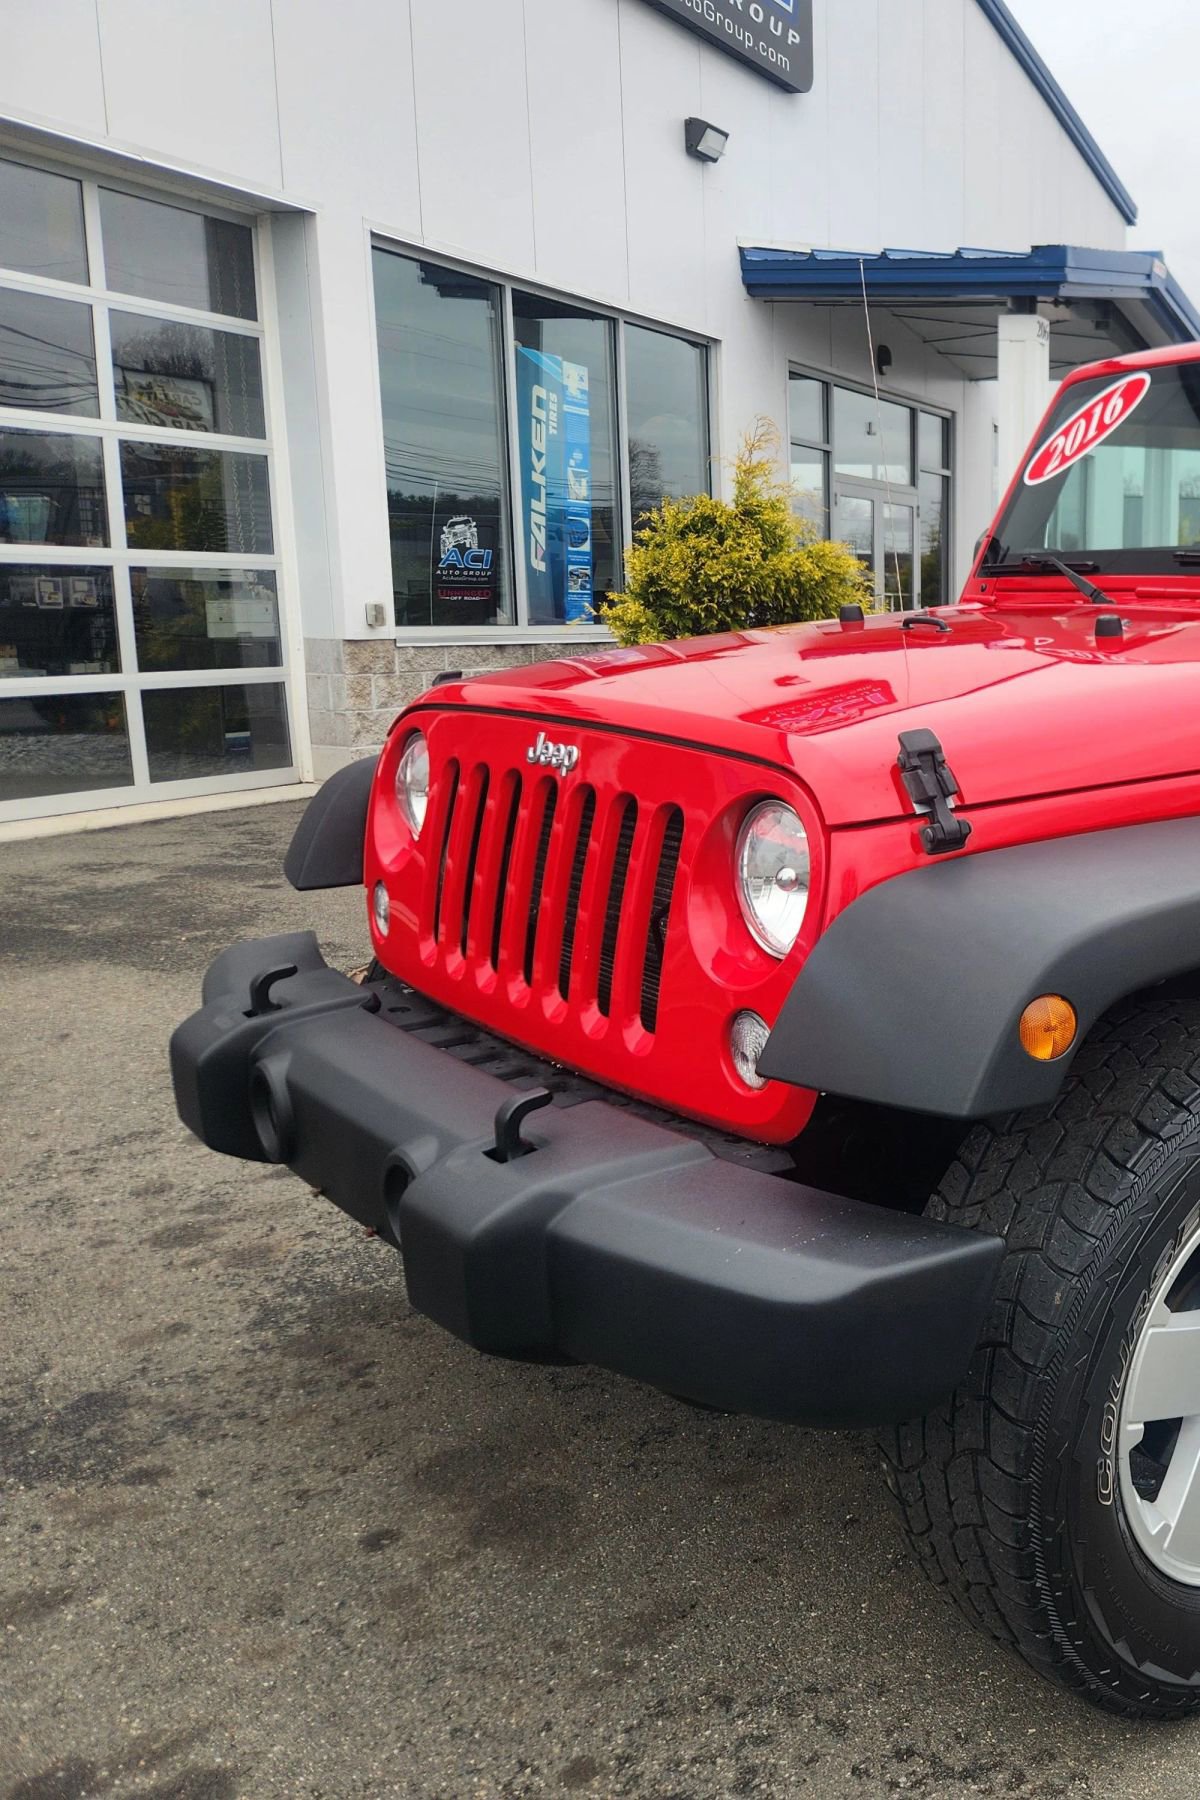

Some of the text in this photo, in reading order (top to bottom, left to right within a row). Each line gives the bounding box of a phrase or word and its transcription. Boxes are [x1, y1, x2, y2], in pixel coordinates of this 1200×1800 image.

[548, 392, 557, 434] TIRES
[1043, 383, 1127, 476] 2016
[531, 384, 546, 573] FALKEN
[438, 547, 492, 569] ACI
[527, 731, 578, 777] Jeep
